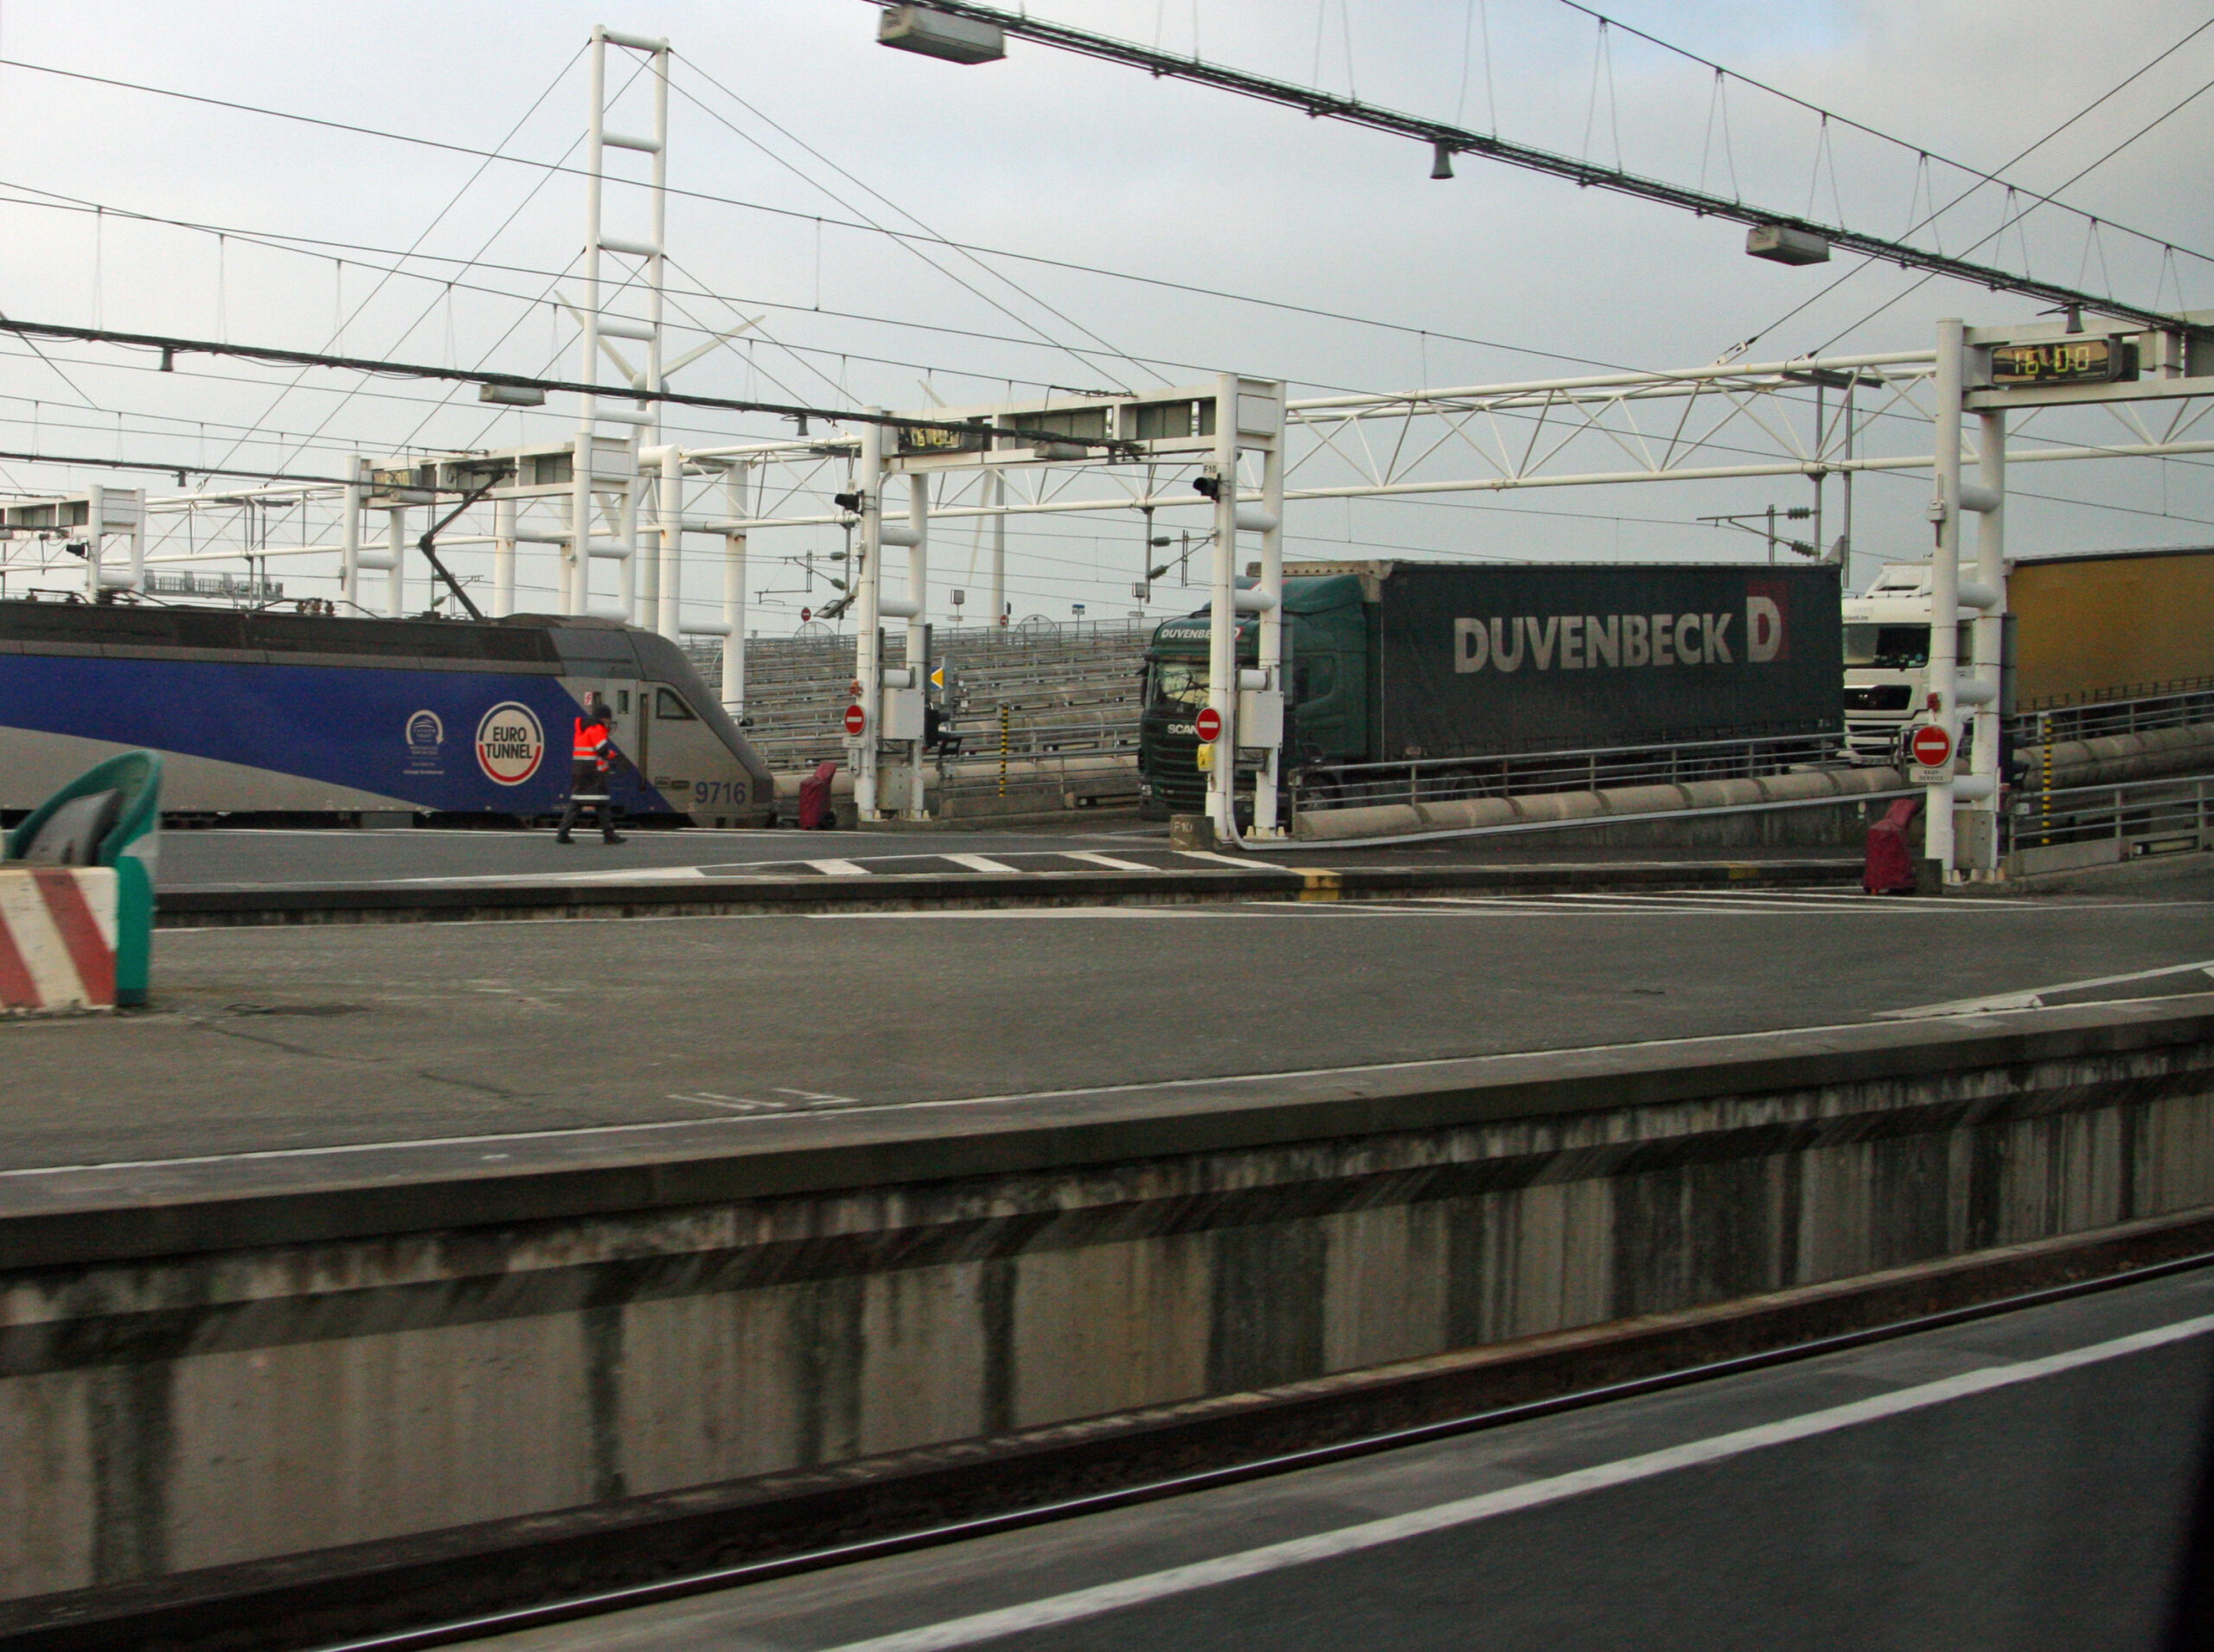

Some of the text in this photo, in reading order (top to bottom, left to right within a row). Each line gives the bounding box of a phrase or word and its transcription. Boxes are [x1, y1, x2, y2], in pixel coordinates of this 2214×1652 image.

[1161, 628, 1212, 638] DUVENBE
[1455, 596, 1782, 673] DUVENBECK D
[493, 727, 527, 742] EURO
[1168, 724, 1198, 734] SCAN
[485, 743, 533, 759] TUNNEL
[695, 781, 745, 804] 9716
